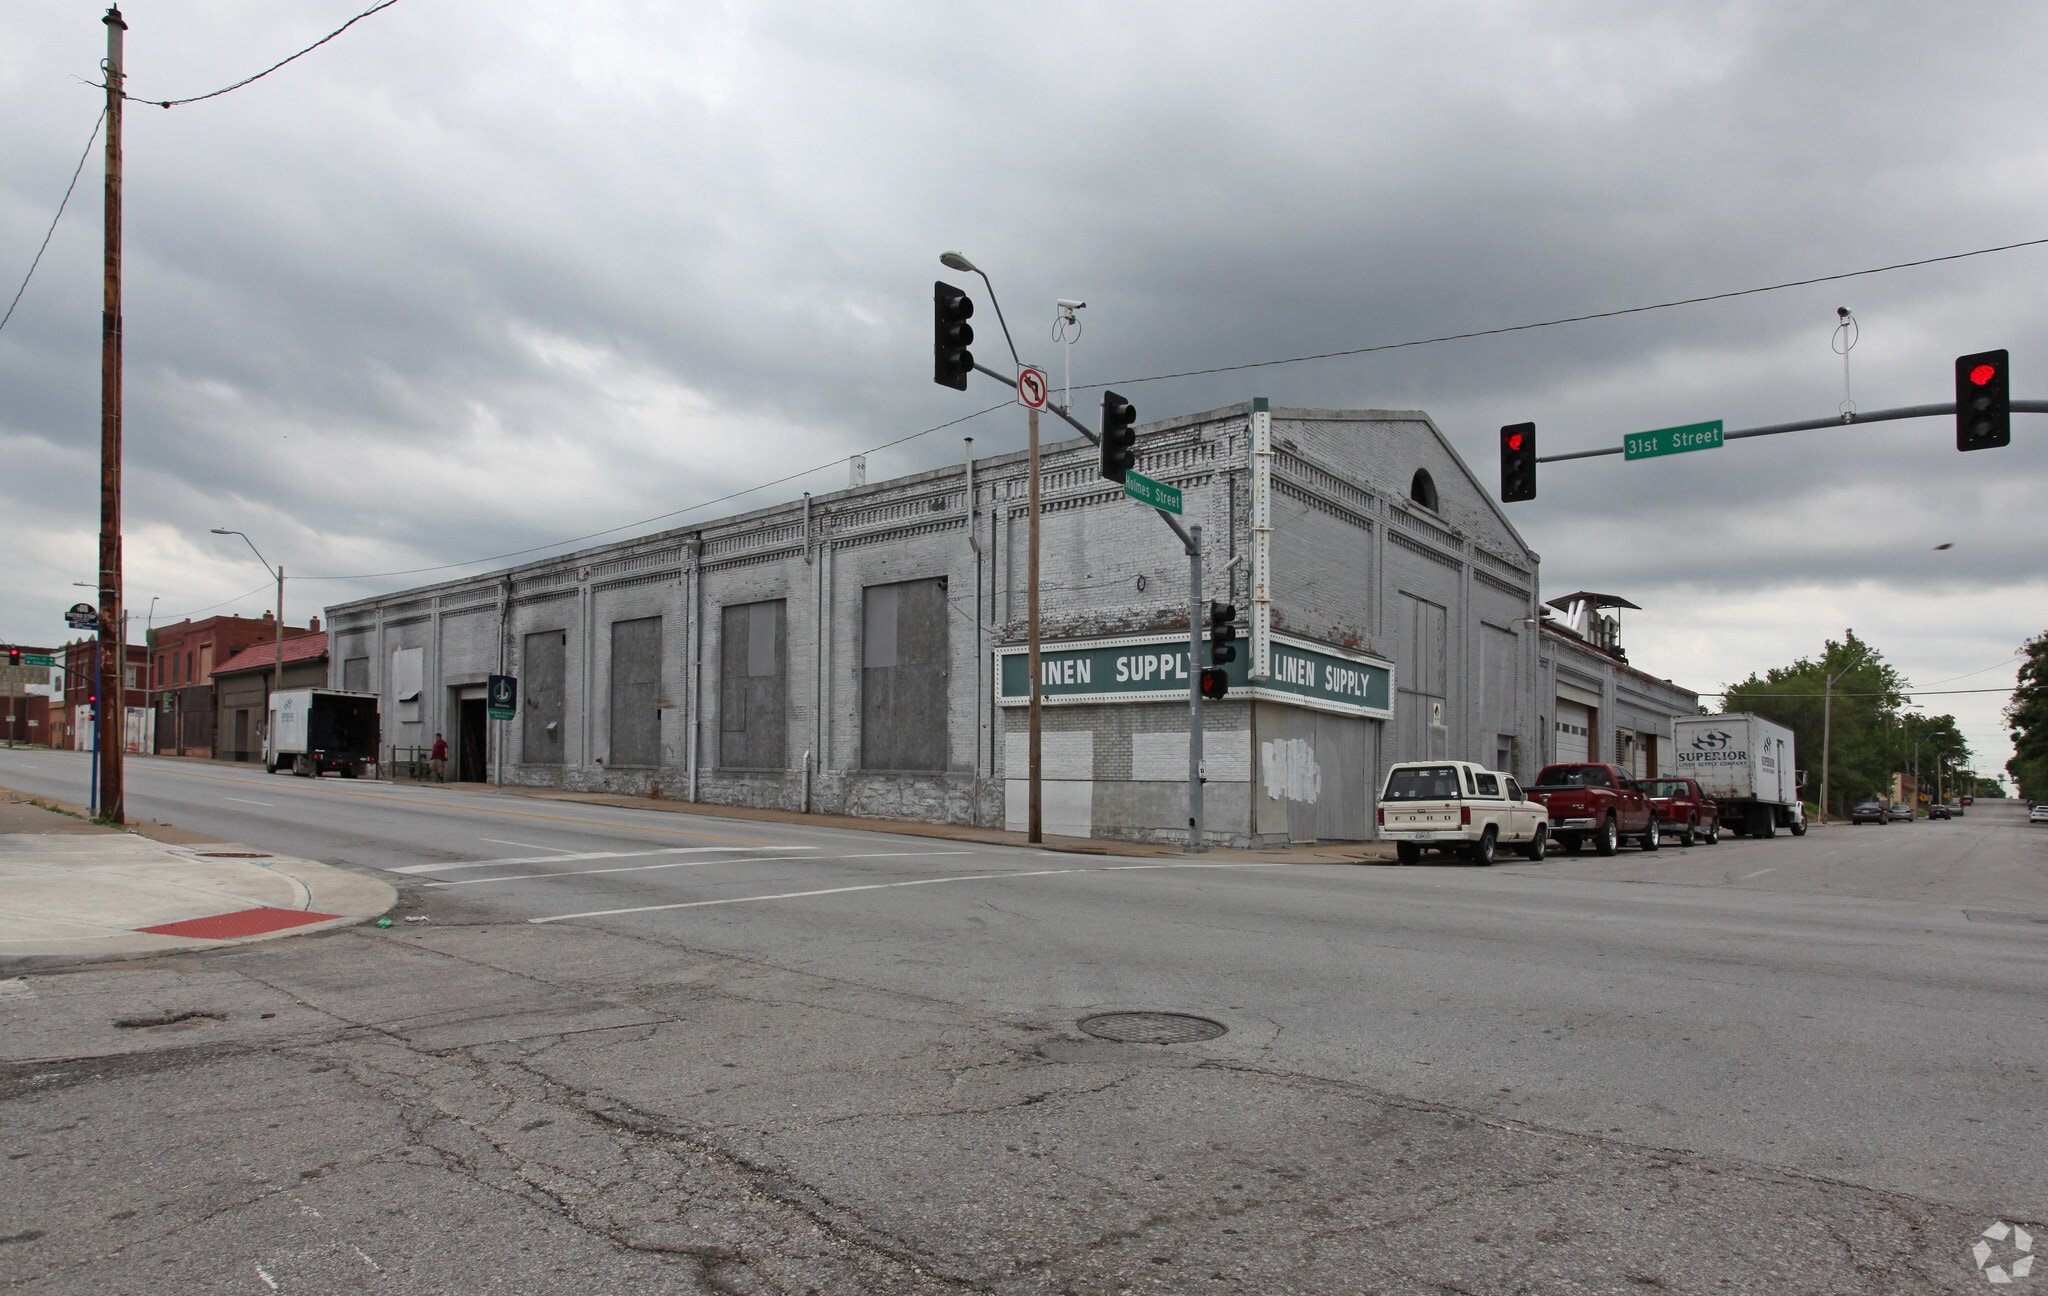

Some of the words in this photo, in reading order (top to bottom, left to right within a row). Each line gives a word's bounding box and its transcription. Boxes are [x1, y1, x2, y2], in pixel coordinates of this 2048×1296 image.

[1628, 437, 1658, 454] 31st
[1672, 427, 1719, 448] Street
[1125, 473, 1151, 498] Holmes
[1155, 487, 1180, 509] Street
[1041, 658, 1091, 686] INEN
[1116, 652, 1191, 682] SUPPL
[1275, 653, 1315, 687] LINEN
[1325, 665, 1370, 697] SUPPLY
[1678, 751, 1747, 762] SUPERIOR
